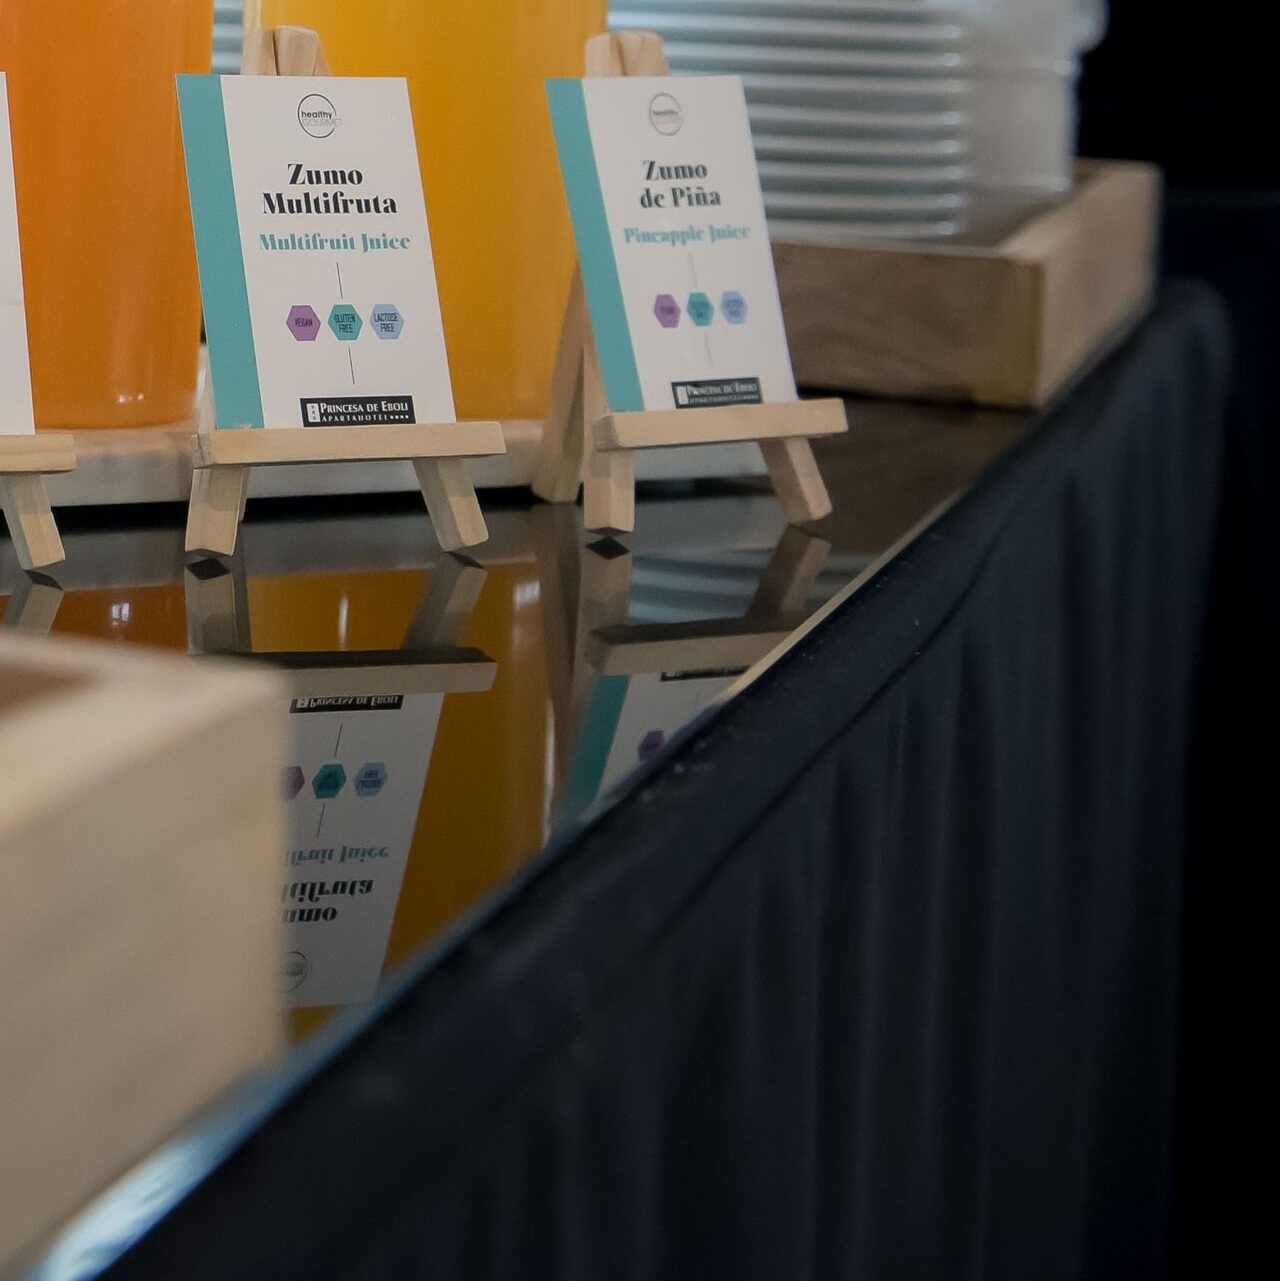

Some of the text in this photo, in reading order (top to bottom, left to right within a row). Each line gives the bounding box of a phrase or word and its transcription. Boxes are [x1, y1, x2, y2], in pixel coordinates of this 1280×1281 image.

[301, 110, 332, 120] healthy
[288, 163, 363, 185] Zumo
[643, 160, 708, 181] Zumo
[263, 191, 397, 214] Multifruta
[640, 186, 721, 208] de Piña
[260, 233, 410, 253] Multifruit Juice
[624, 225, 750, 246] Pineapple Juice
[295, 318, 313, 327] VEGAN
[338, 324, 353, 333] FREE
[380, 323, 395, 332] FREE
[320, 401, 408, 413] PRINCESA DE EBOLI
